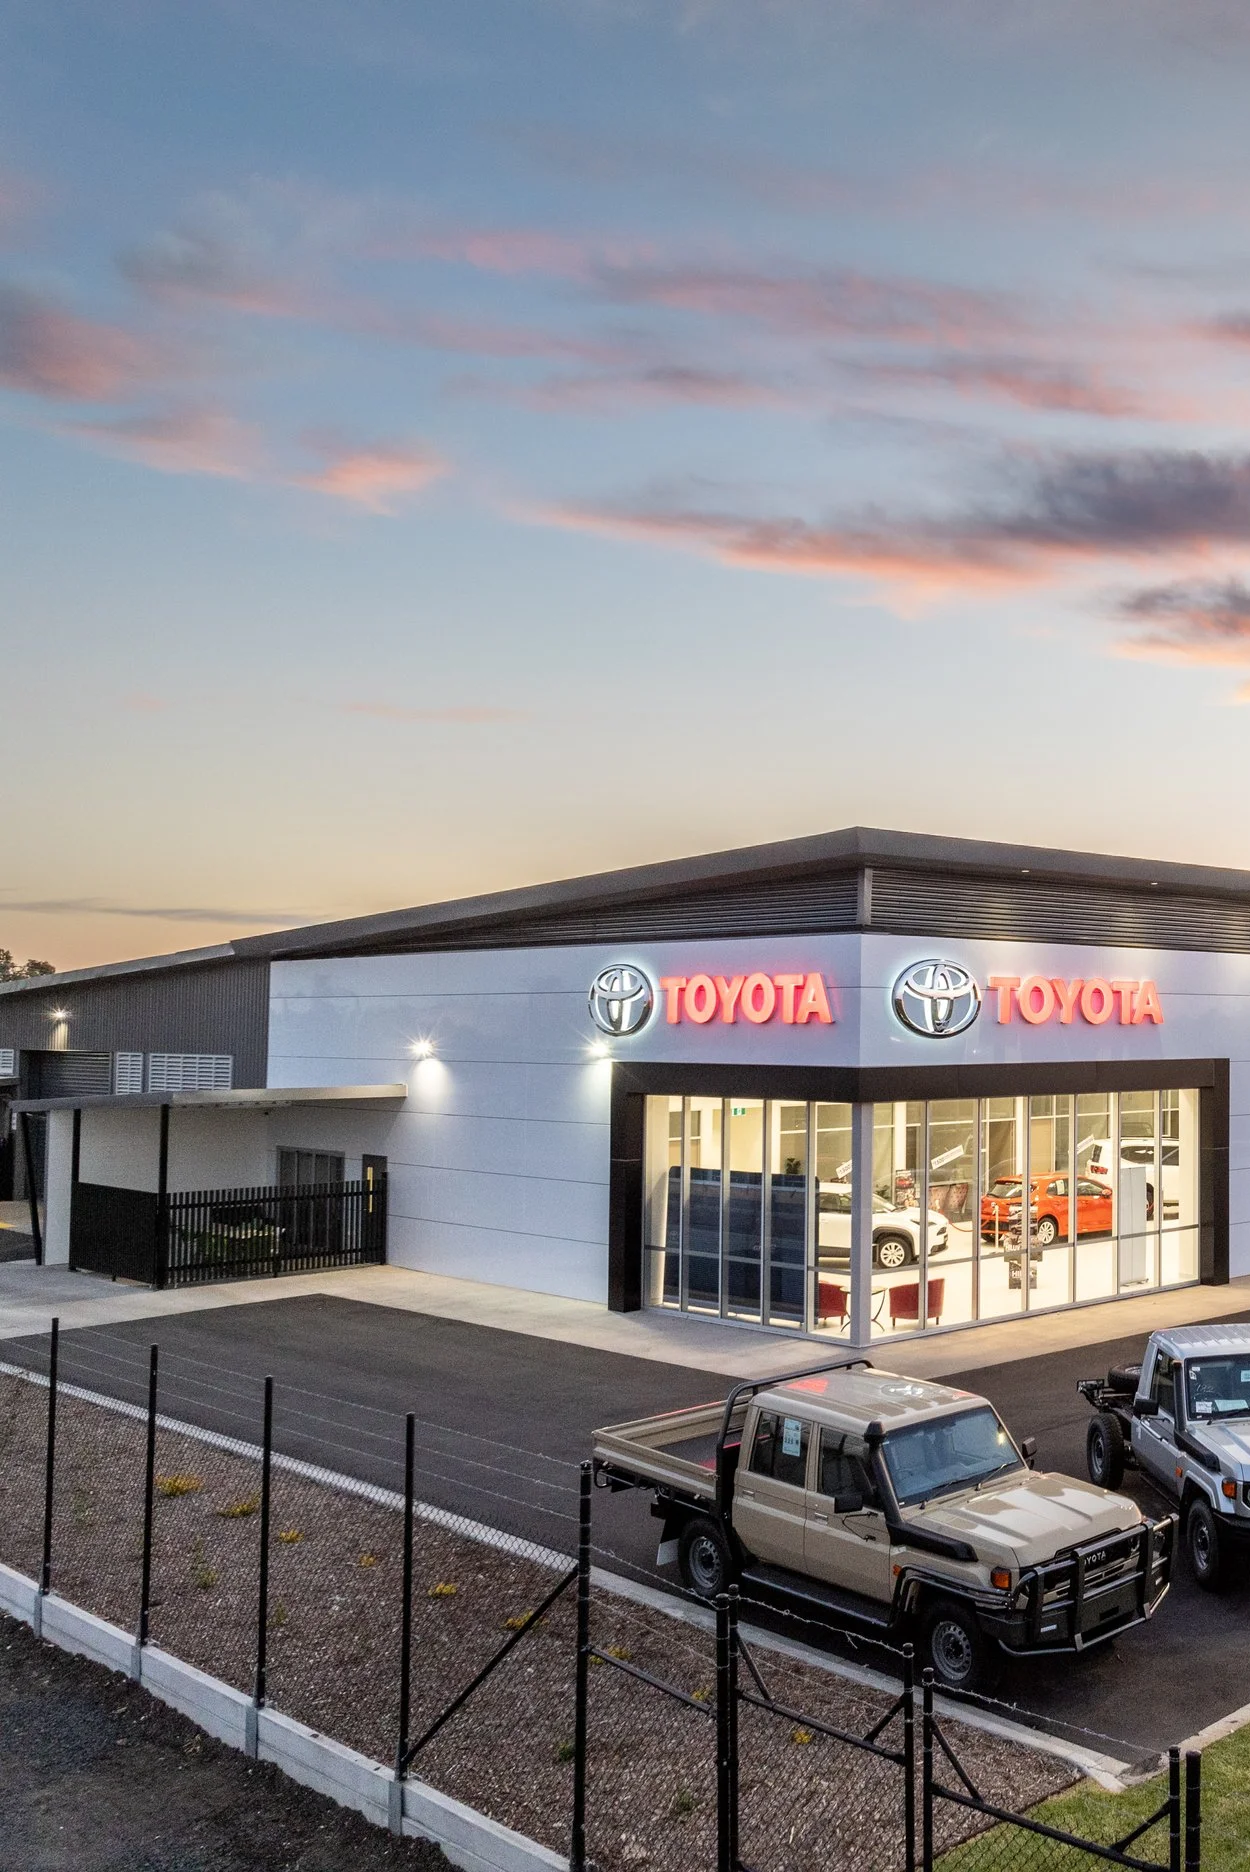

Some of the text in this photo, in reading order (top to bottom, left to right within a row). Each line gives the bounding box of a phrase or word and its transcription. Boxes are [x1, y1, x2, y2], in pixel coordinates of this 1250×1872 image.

[660, 972, 833, 1025] TOYOTA
[989, 975, 1165, 1025] TOYOTA
[1084, 1550, 1106, 1565] YOTA
